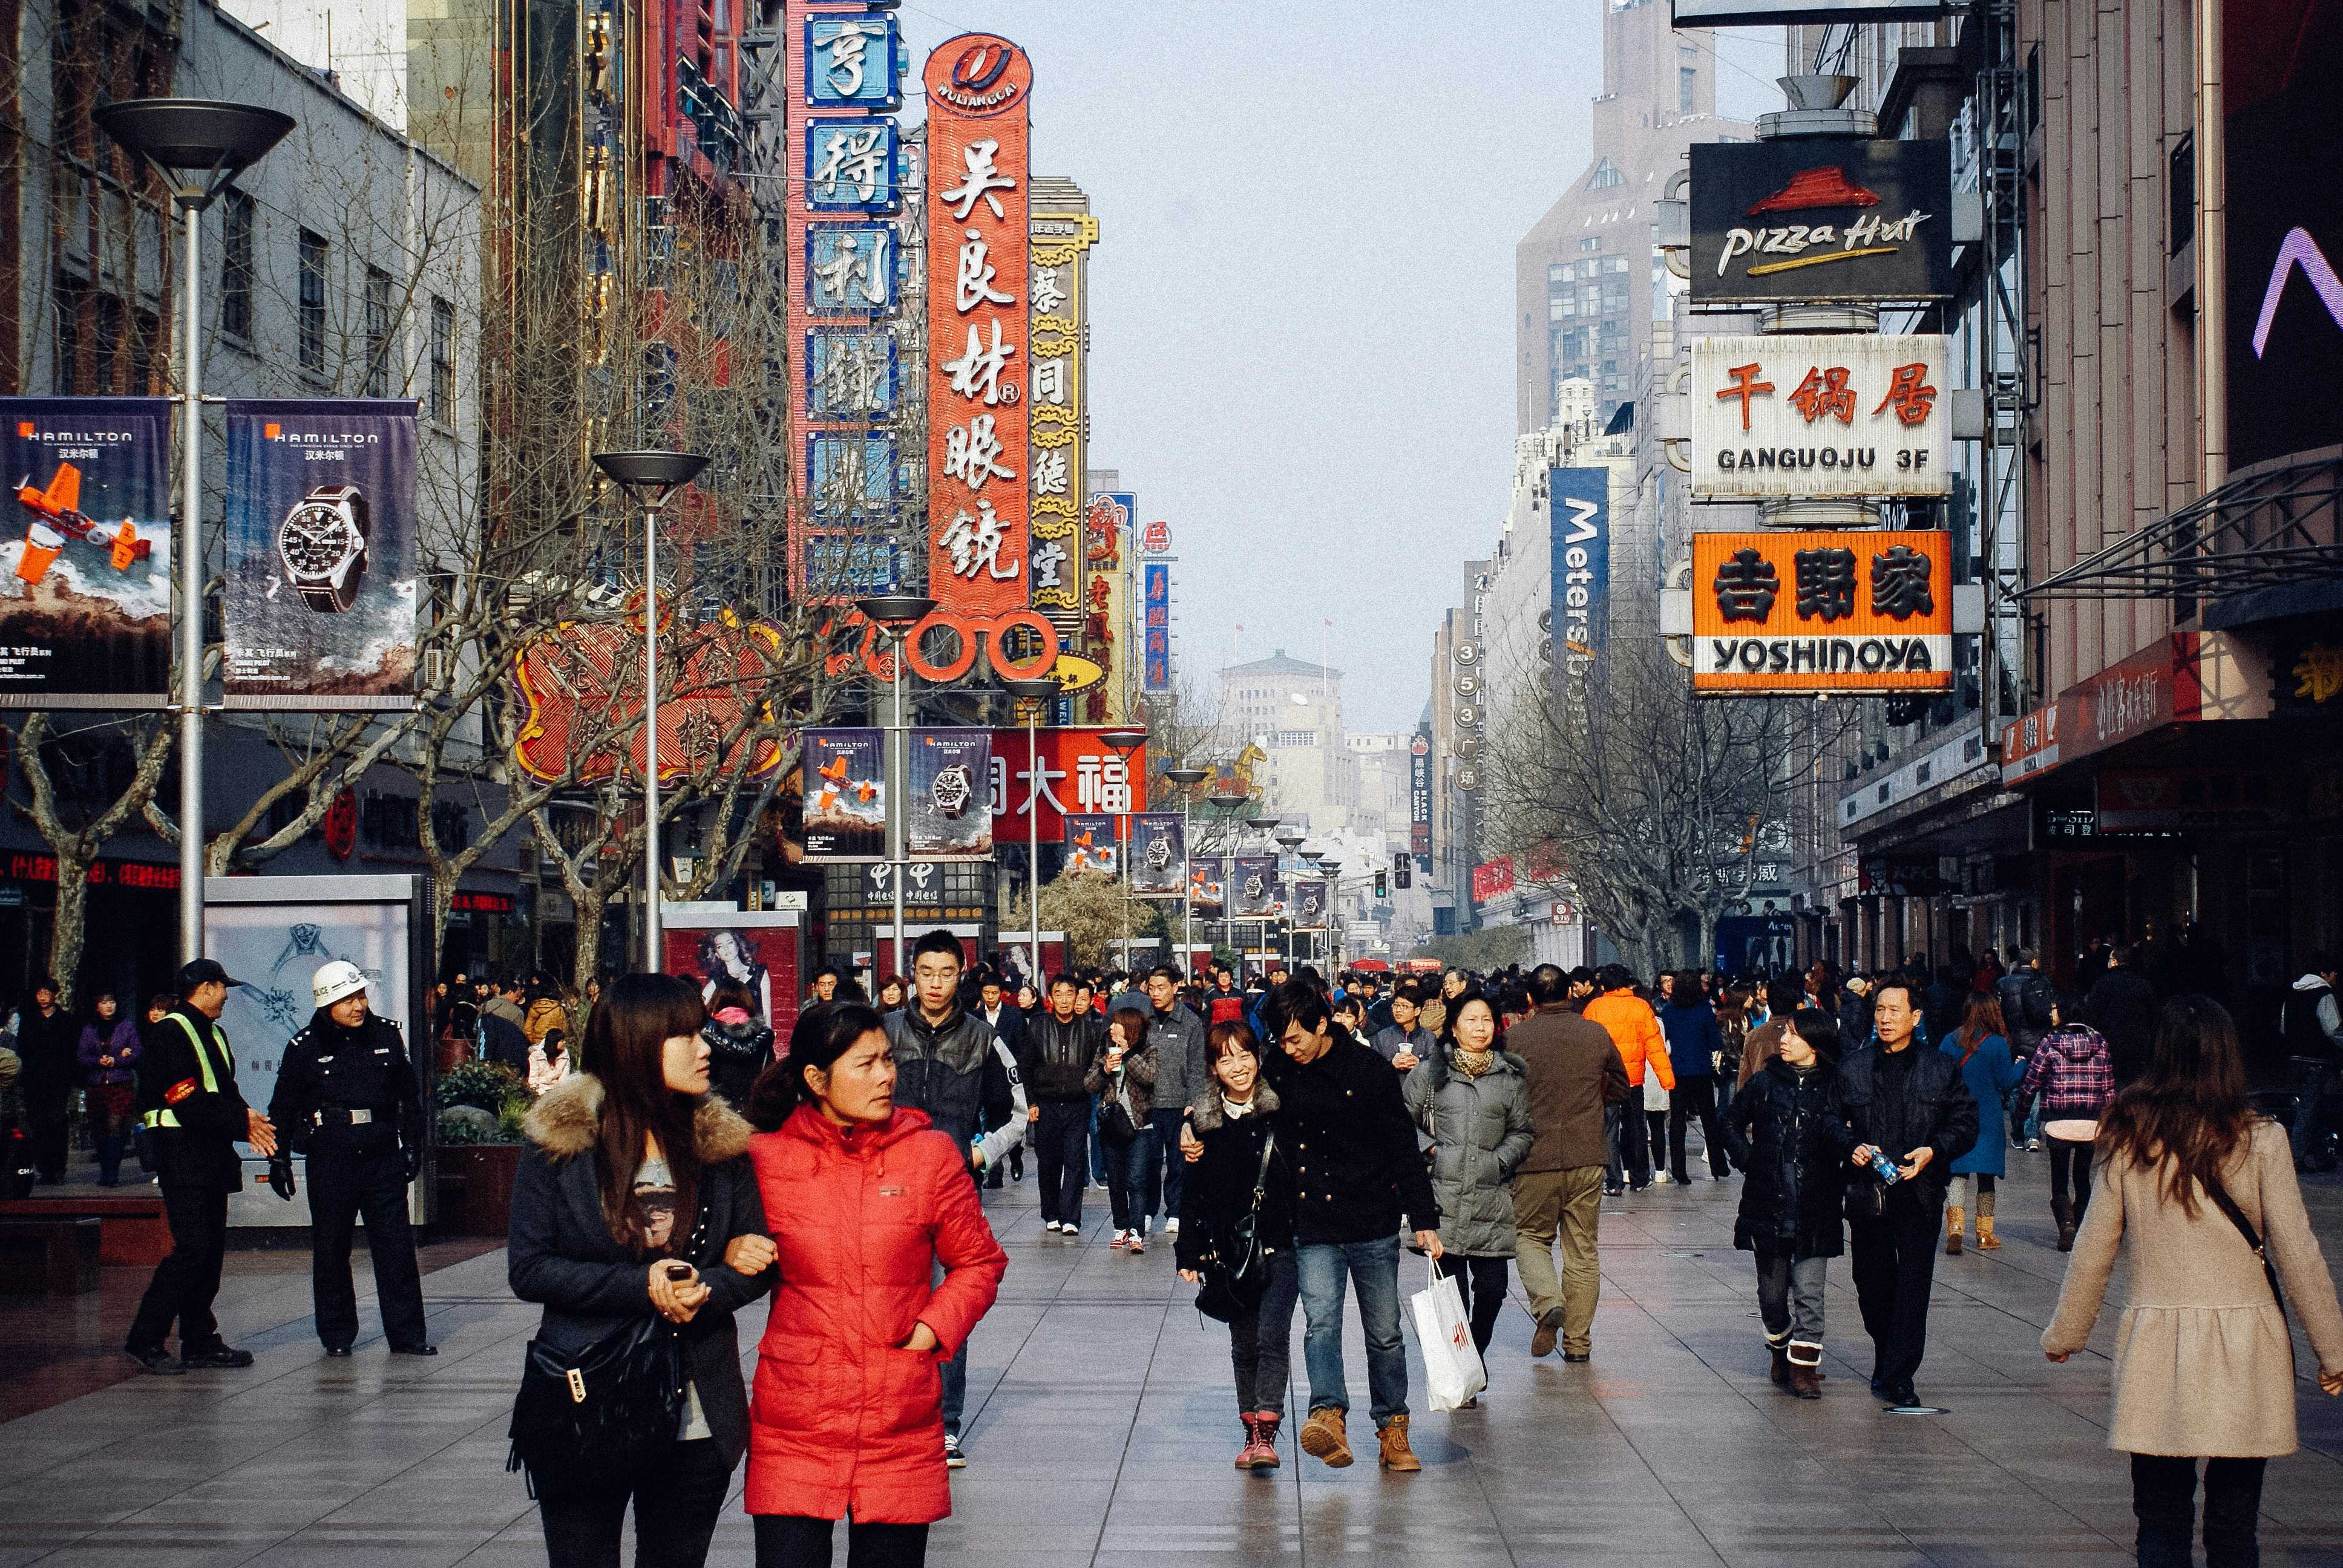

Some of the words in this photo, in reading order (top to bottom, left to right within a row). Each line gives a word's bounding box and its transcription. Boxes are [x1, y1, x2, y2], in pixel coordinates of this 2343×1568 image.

[937, 81, 1018, 108] WULIANGCAI
[1844, 209, 1932, 249] Hut
[1716, 362, 1937, 430] 干锅居
[28, 433, 133, 442] HAMILTON
[275, 434, 378, 443] HAMILTON
[59, 448, 99, 459] 汉米尔顿
[306, 450, 344, 460] 汉米尔顿
[1718, 448, 1875, 469] GANGUOJU
[1896, 448, 1930, 469] 3F
[1714, 546, 1934, 623] 吉野家
[1713, 638, 1932, 671] YOSHINOYA
[906, 890, 937, 900] 中国电信
